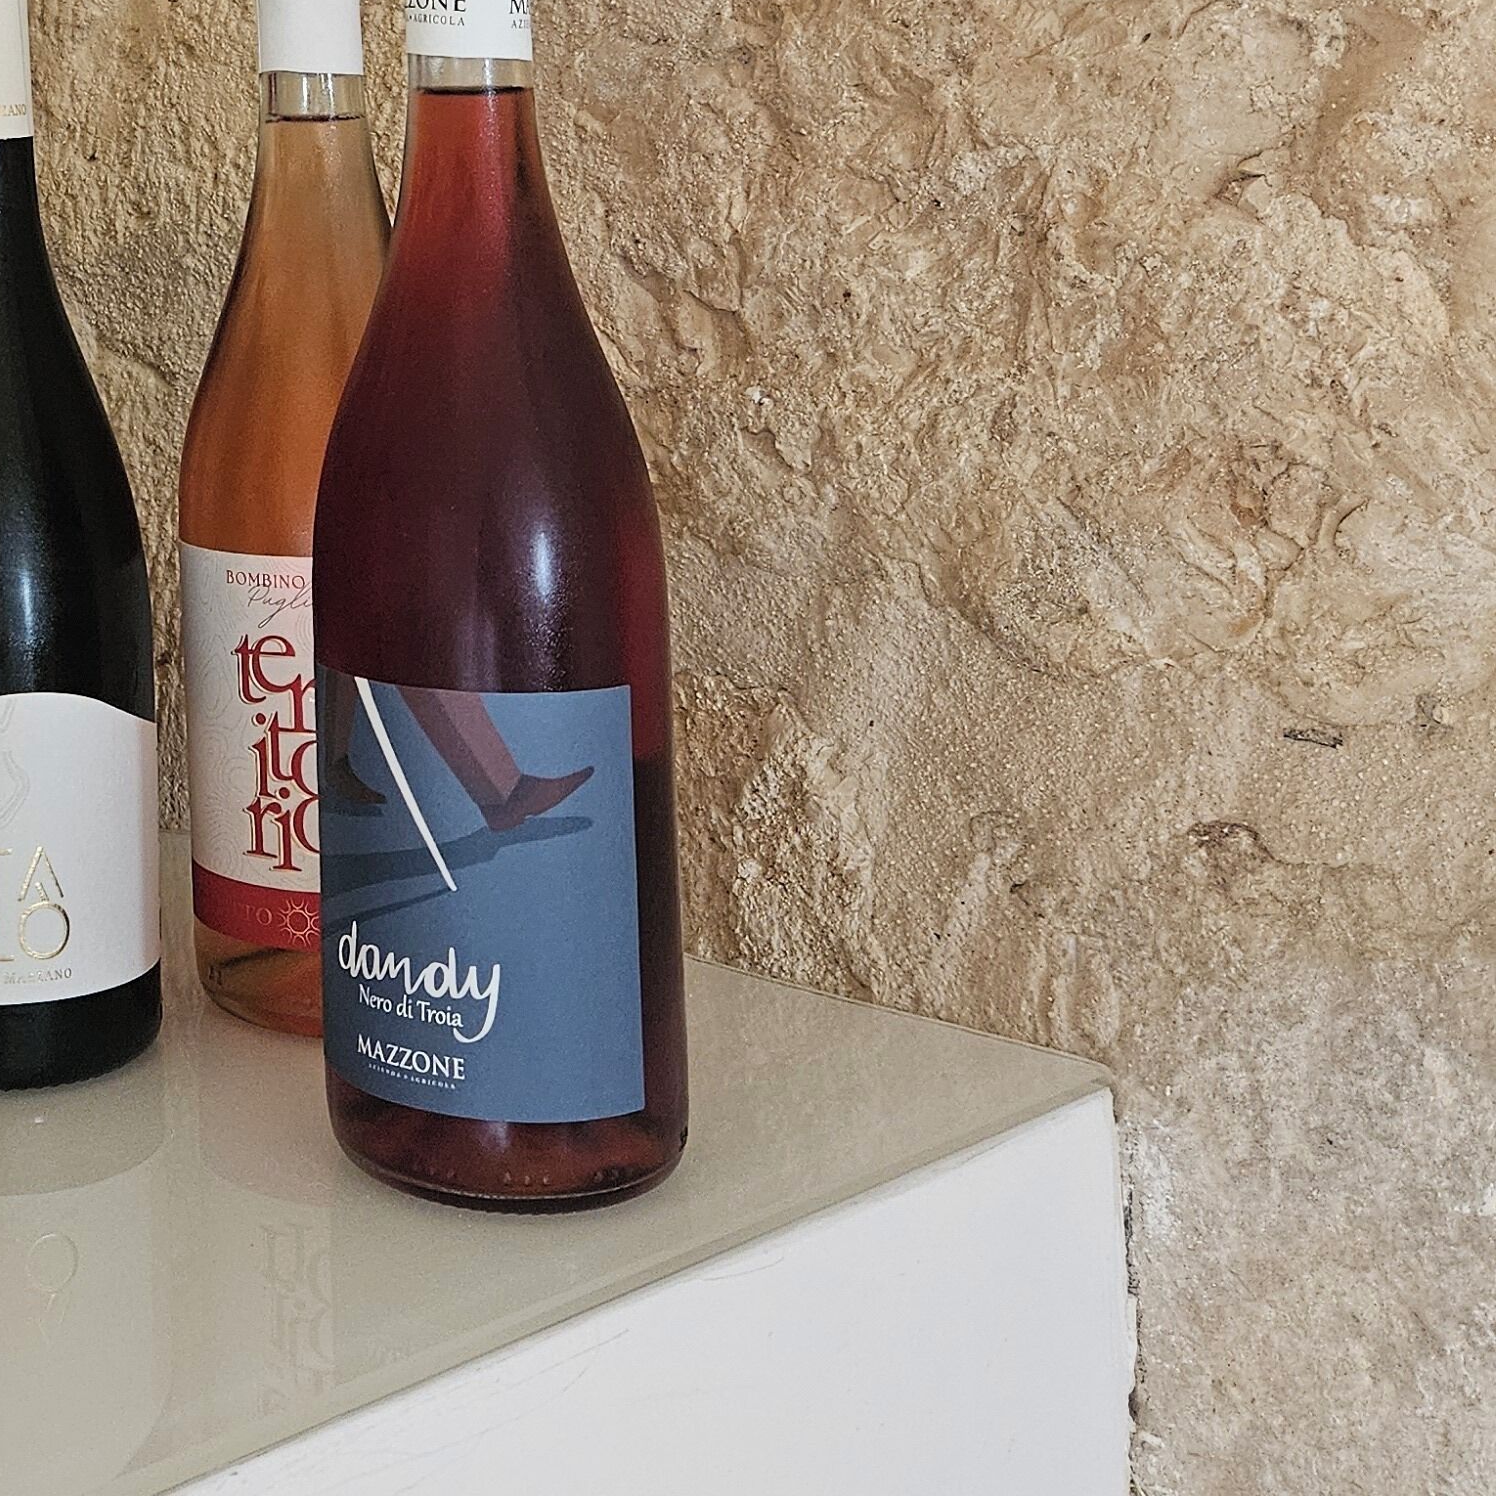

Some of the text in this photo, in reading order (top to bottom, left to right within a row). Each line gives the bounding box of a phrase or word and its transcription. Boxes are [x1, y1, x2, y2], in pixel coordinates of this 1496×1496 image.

[225, 569, 306, 590] BOMBINO
[338, 920, 501, 1044] dandy
[359, 983, 464, 1029] Nero di Troia
[357, 1033, 466, 1081] MAZZONE
